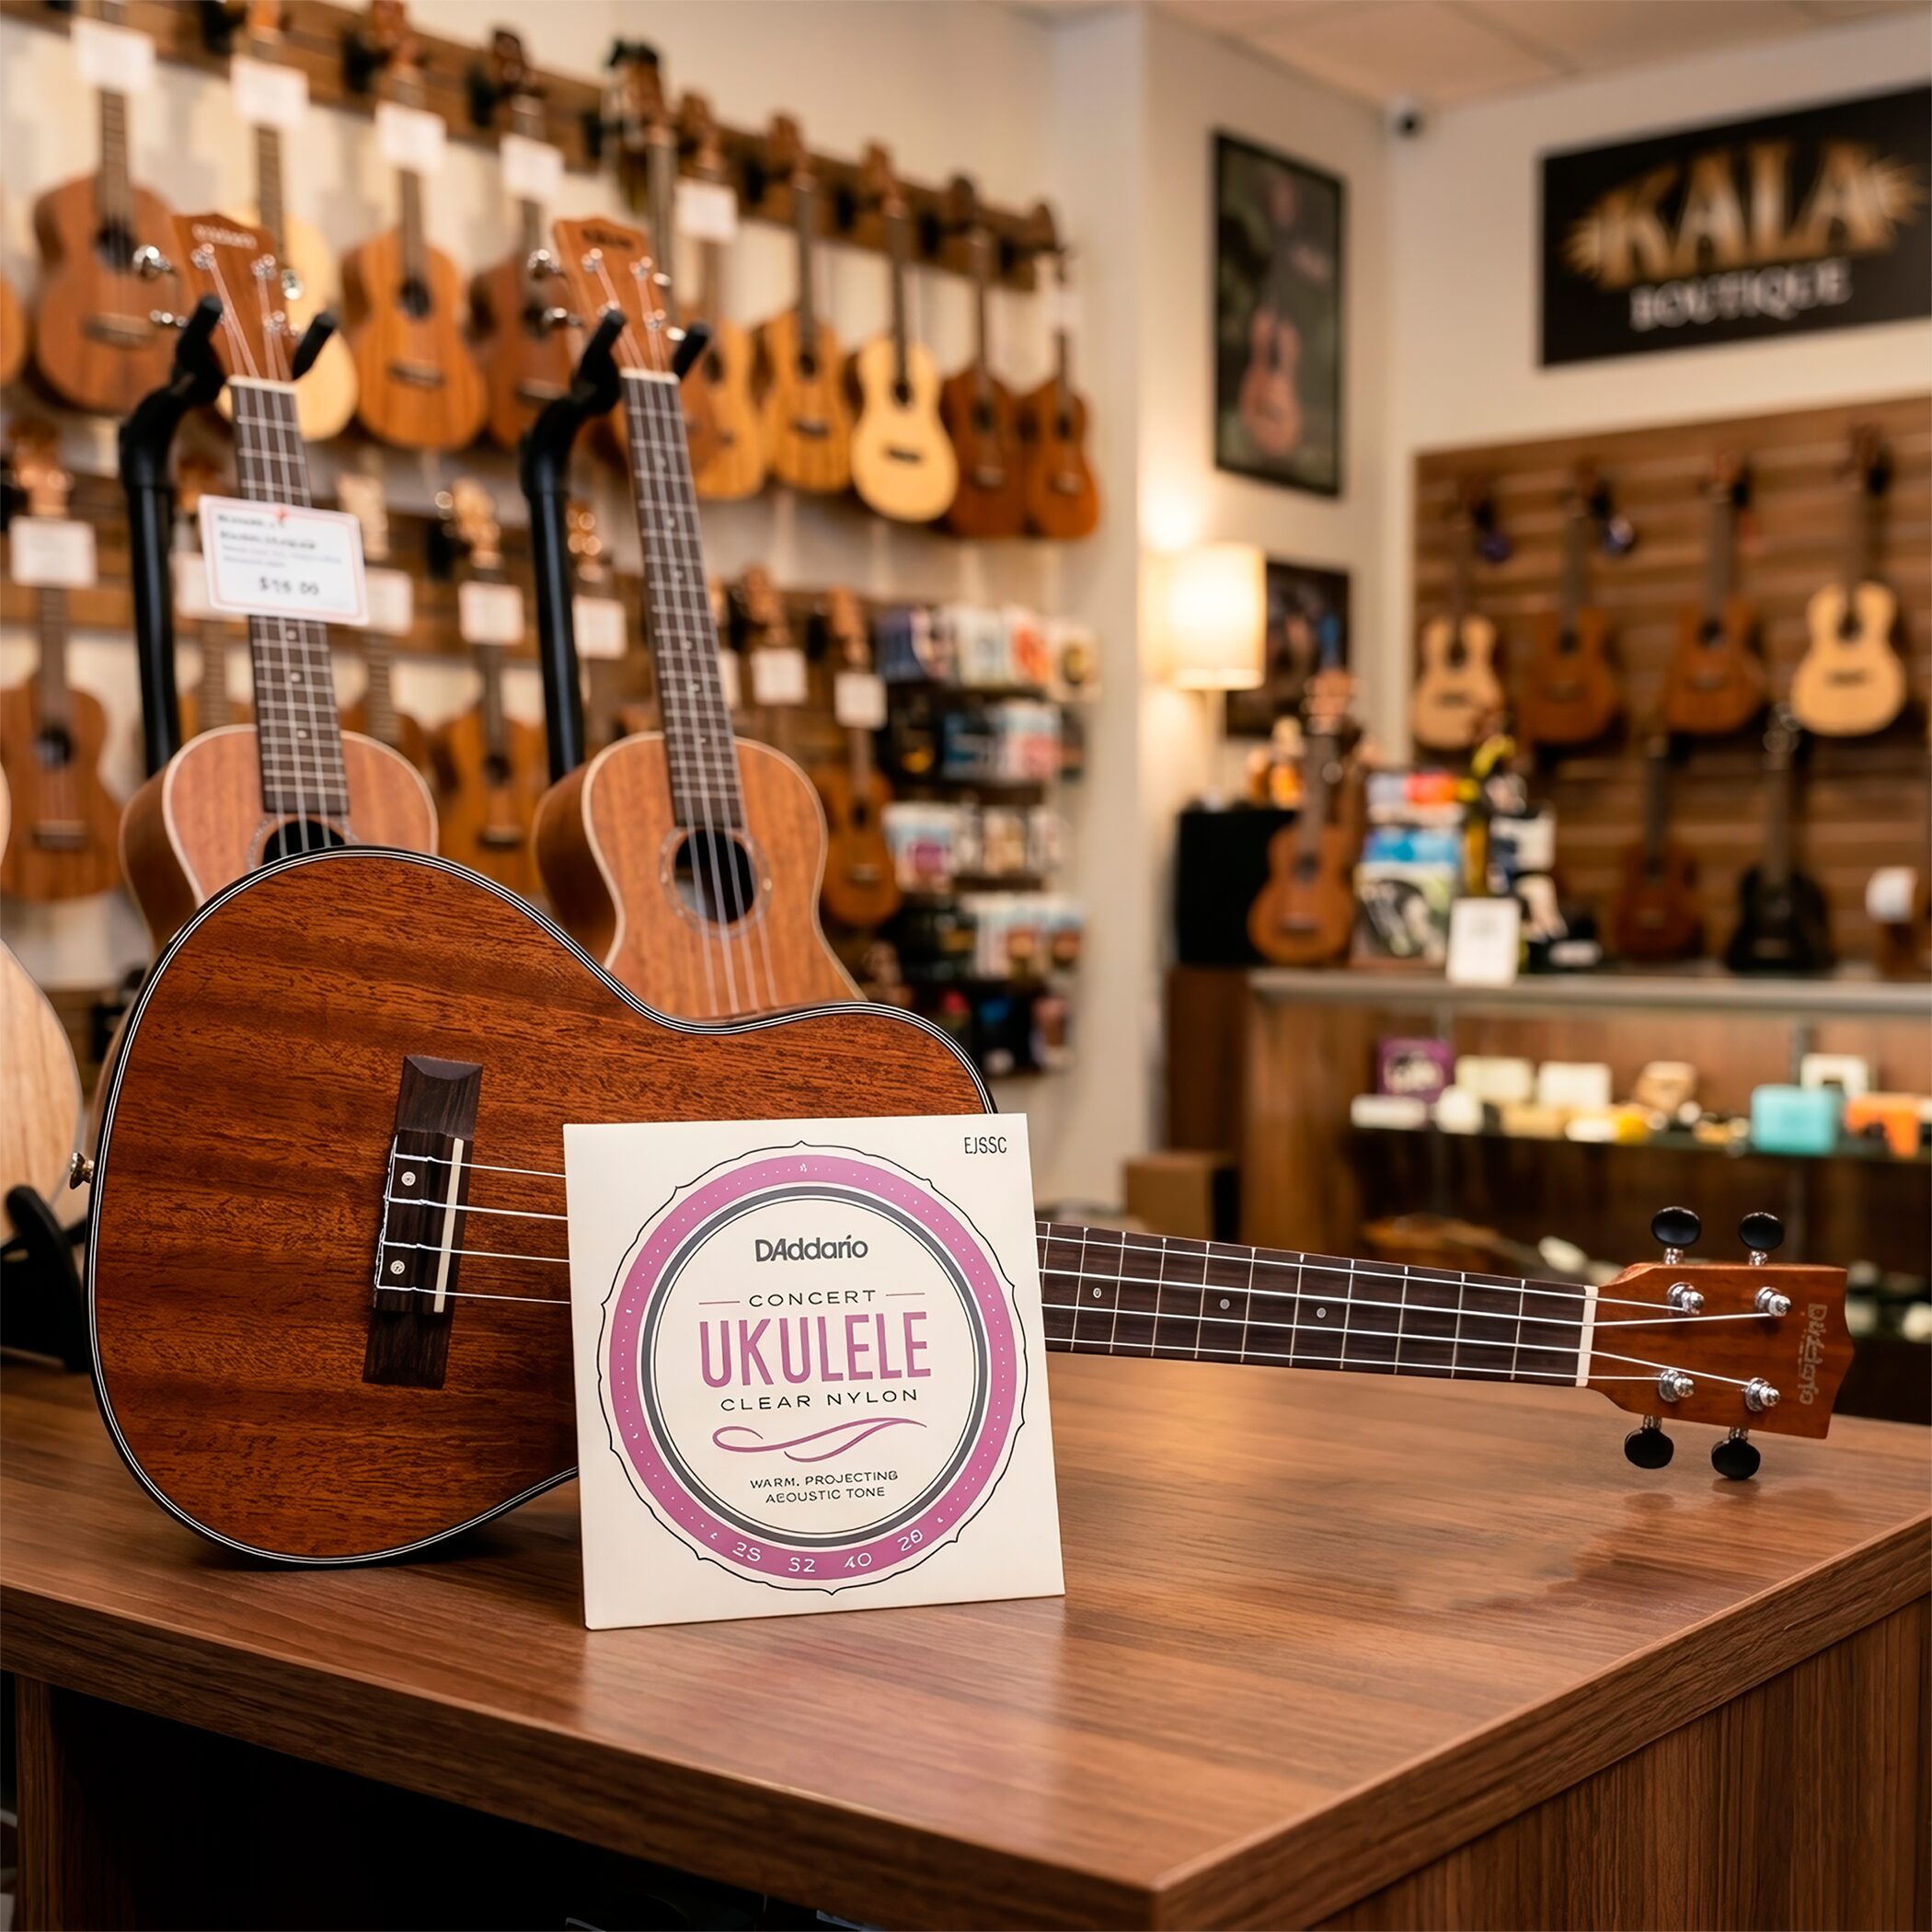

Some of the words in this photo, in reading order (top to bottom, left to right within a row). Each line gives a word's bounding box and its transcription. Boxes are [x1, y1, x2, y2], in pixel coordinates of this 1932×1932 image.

[1590, 140, 1899, 293] KALA
[1629, 258, 1853, 333] BOUTIQUE
[748, 1289, 877, 1308] CONCERT
[699, 1311, 932, 1388] UKULELE
[720, 1395, 811, 1412] CLEAR
[827, 1389, 918, 1406] NYLON
[846, 1486, 886, 1500] TONE
